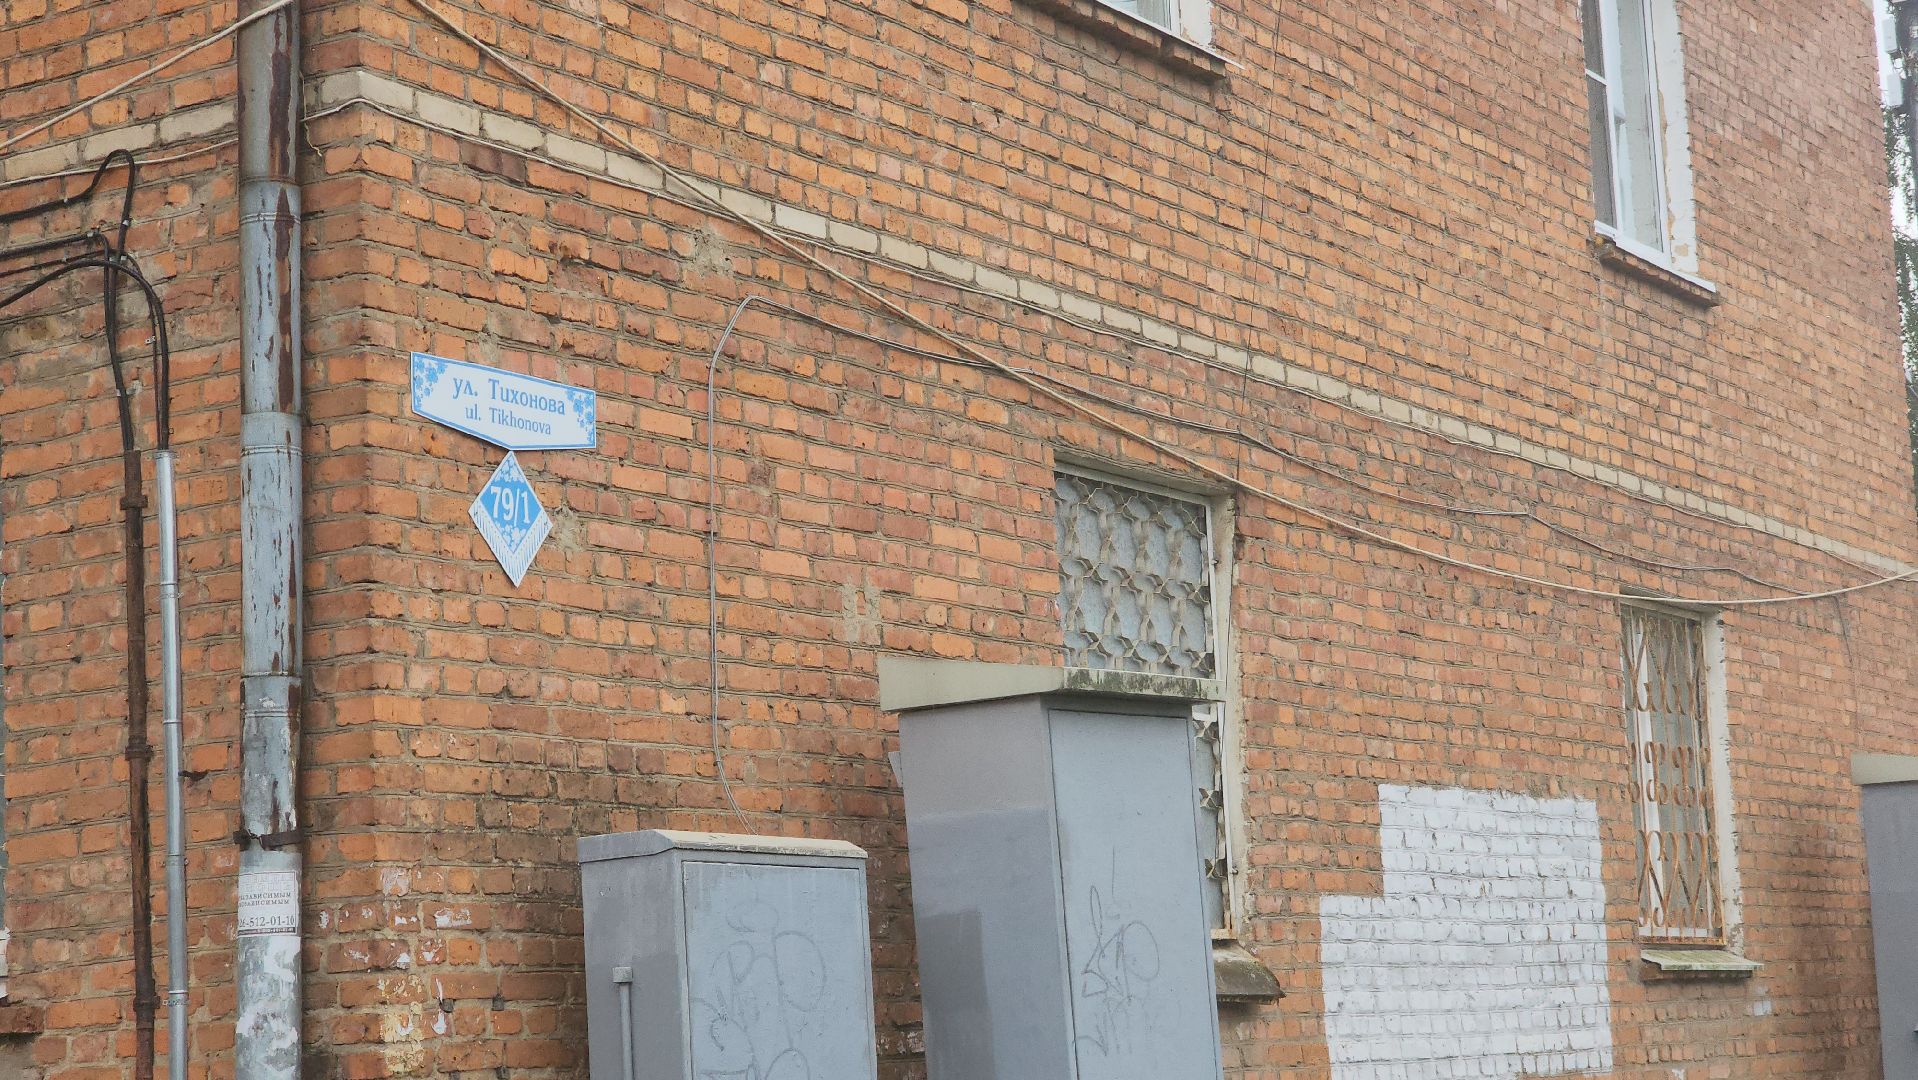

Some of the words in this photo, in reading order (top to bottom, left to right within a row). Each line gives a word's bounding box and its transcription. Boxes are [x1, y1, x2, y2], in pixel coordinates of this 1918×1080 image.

[452, 377, 478, 399] ул.
[488, 378, 565, 415] Тихонова
[465, 404, 481, 421] ul.
[489, 407, 551, 435] Tikhonova
[490, 486, 530, 527] 79/1
